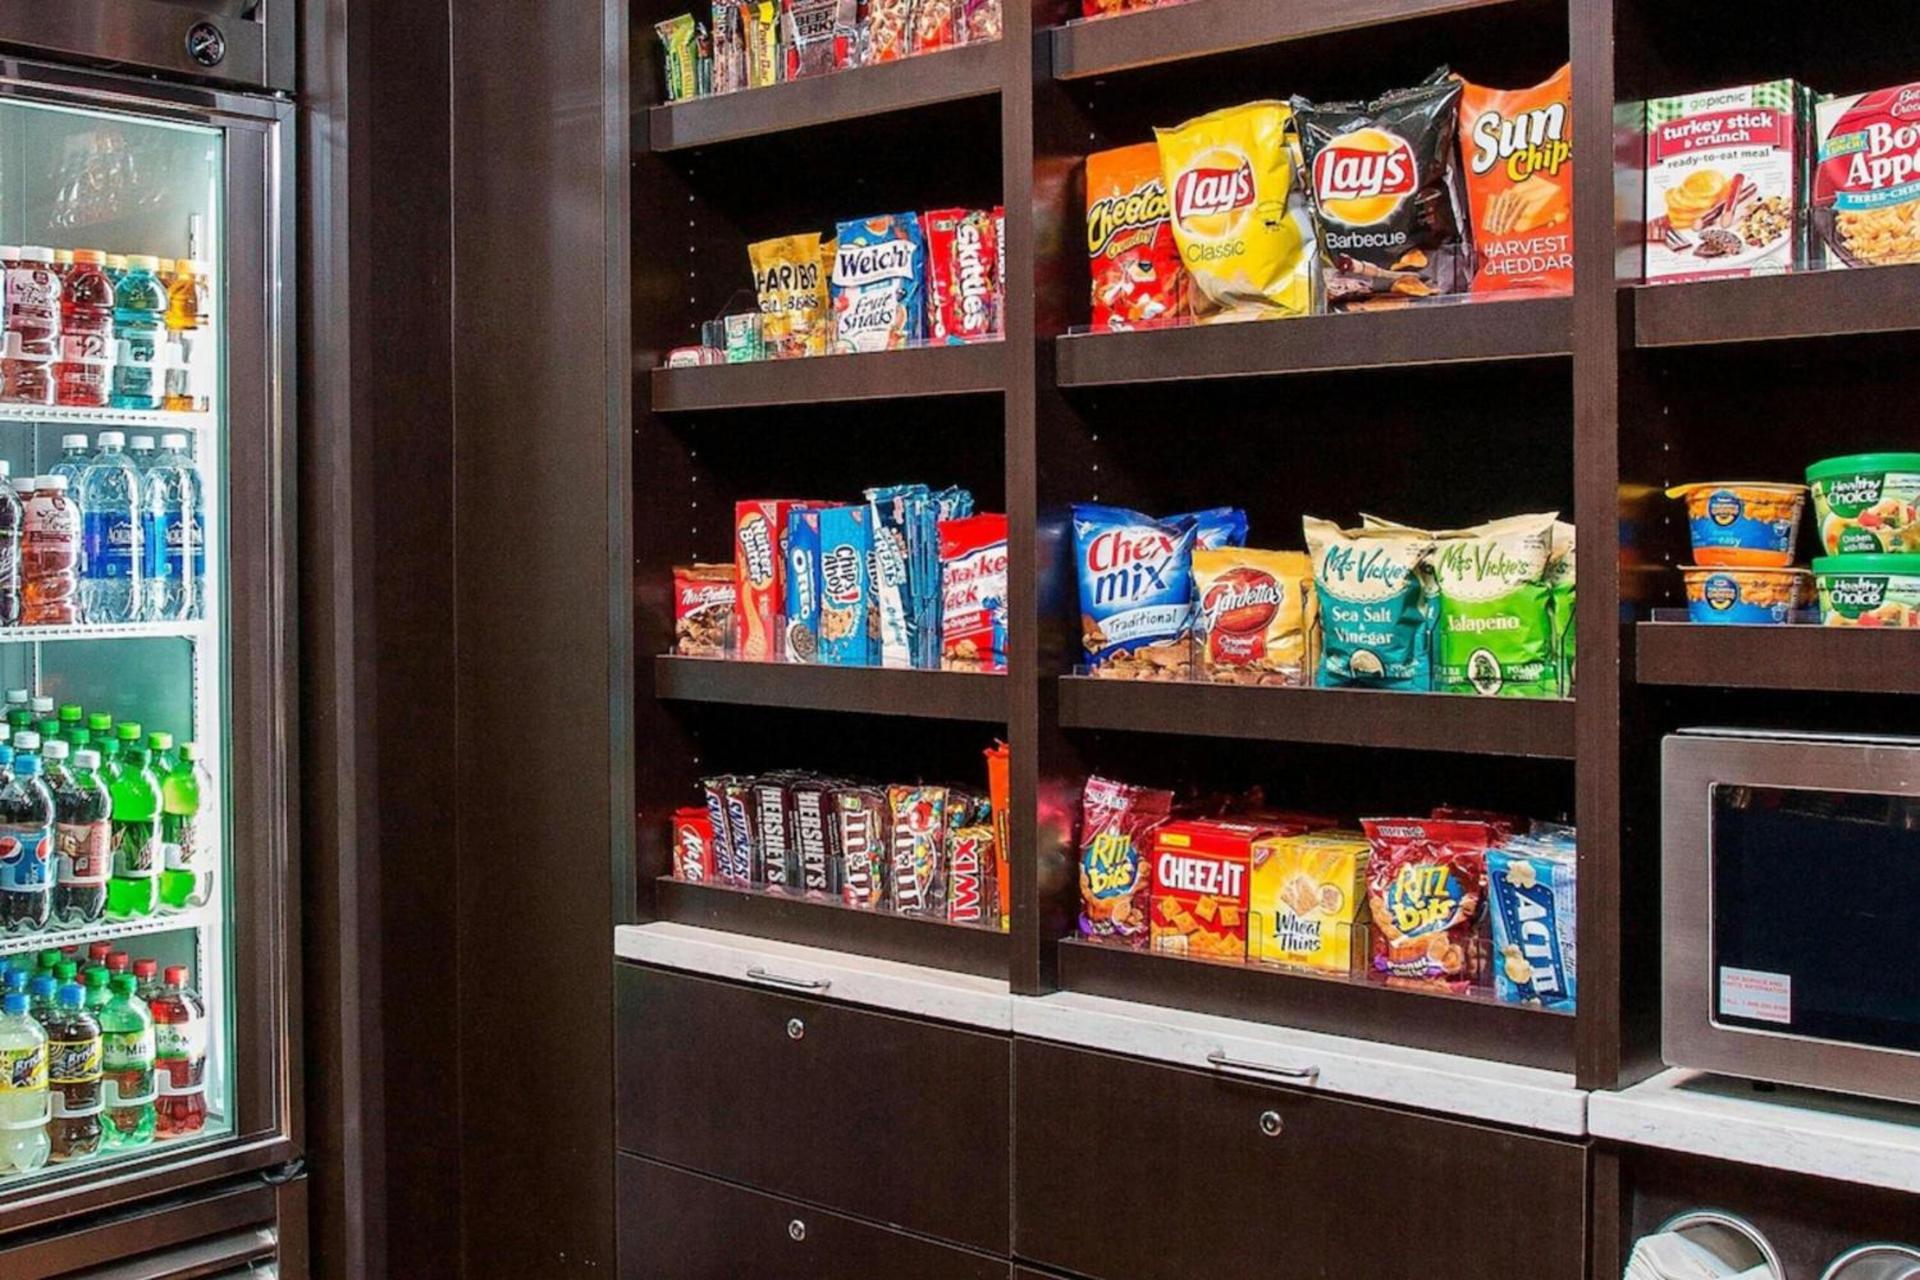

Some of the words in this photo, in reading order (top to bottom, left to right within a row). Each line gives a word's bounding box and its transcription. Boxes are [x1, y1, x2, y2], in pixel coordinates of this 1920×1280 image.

[798, 19, 836, 36] ERKY
[760, 22, 771, 82] PowerBar
[1690, 91, 1746, 112] gopicnic
[1471, 102, 1566, 175] Sun
[1663, 118, 1723, 141] turkey
[1727, 112, 1773, 129] stick
[1695, 129, 1750, 147] crunch
[1864, 122, 1920, 158] Bo
[1319, 146, 1409, 200] Lay's
[1506, 140, 1573, 182] Chip
[1667, 150, 1738, 169] ready-to-eat
[1741, 147, 1770, 158] meal
[1179, 161, 1251, 218] Lay's
[1186, 239, 1246, 264] Classic
[1325, 230, 1407, 249] Barbecue
[1484, 235, 1569, 258] HARVEST
[757, 263, 817, 293] HARIBO
[957, 223, 987, 330] Skittles
[1485, 255, 1574, 276] CHEDDAR
[840, 306, 893, 334] Snacks
[855, 293, 893, 320] Fruit
[1827, 489, 1878, 507] Choice
[1830, 474, 1882, 493] Healthy
[739, 525, 763, 585] Butter
[750, 518, 773, 577] Nutter
[1087, 531, 1174, 573] Chex
[835, 546, 857, 592] Chips
[1475, 542, 1530, 584] Vickie's
[792, 549, 811, 619] OREO
[1094, 562, 1168, 606] mix
[1830, 589, 1881, 605] Choice
[1834, 578, 1885, 593] Healthy
[1109, 609, 1177, 633] Traditional
[1332, 605, 1359, 622] Sea
[1363, 605, 1393, 622] Salt
[1448, 612, 1521, 634] Jalapeño
[1334, 627, 1394, 645] Vinegar
[762, 788, 786, 883] HERSHEY'S
[798, 791, 826, 888] HERSHEY'S
[949, 837, 978, 920] TWIX
[1088, 862, 1133, 894] bits
[1158, 852, 1245, 897] CHEEZ-IT
[1275, 910, 1321, 937] Wheat
[1392, 898, 1457, 932] bits
[1514, 892, 1553, 960] ACT
[1272, 933, 1321, 952] Thins
